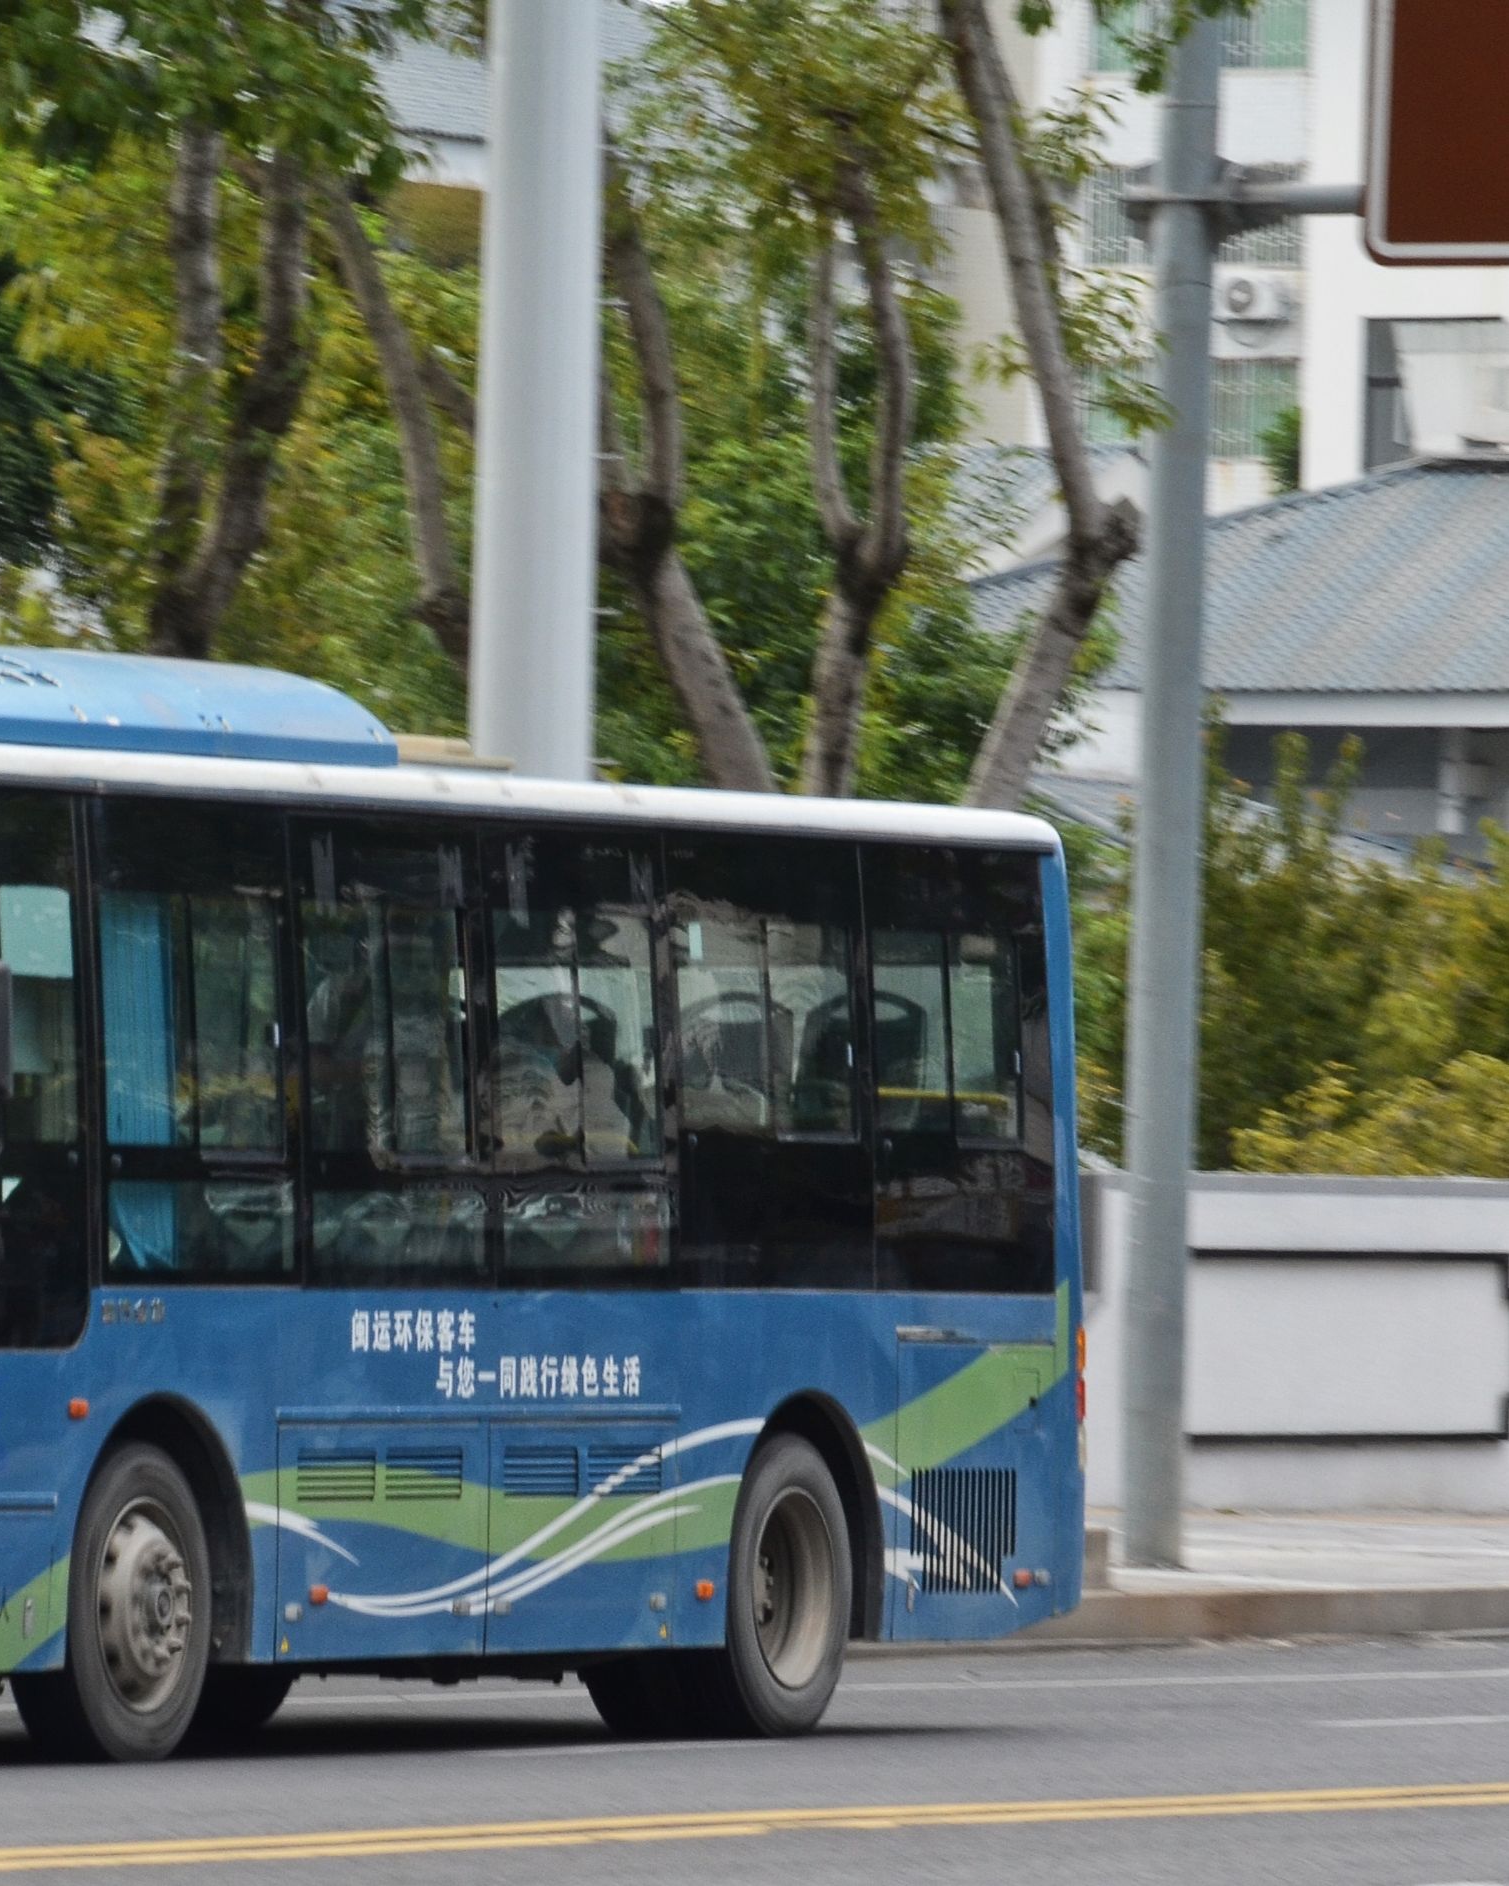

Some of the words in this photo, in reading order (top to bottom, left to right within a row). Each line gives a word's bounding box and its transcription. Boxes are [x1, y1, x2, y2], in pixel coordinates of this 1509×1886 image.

[351, 1308, 476, 1352] 闽运环保客车
[436, 1354, 640, 1398] 与您一同践行绿色生活
